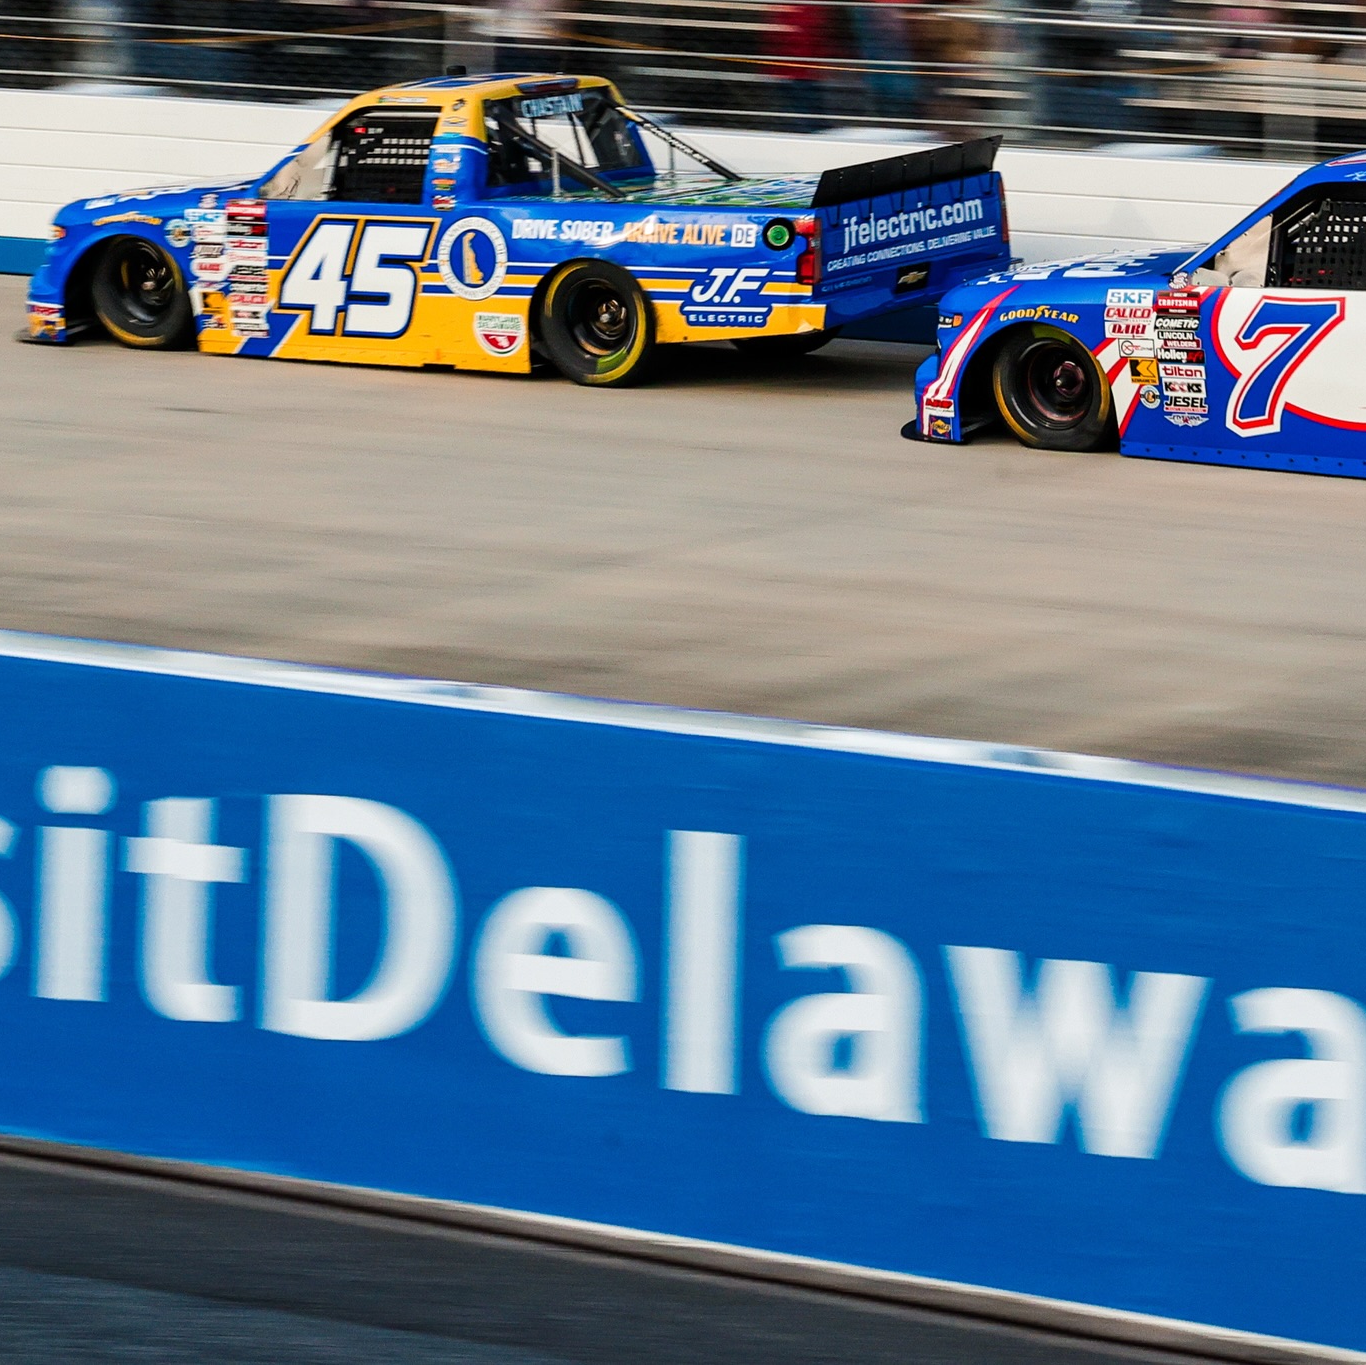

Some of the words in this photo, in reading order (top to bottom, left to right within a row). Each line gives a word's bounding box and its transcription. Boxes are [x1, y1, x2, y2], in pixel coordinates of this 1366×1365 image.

[511, 218, 559, 240] DRIVE
[560, 220, 616, 241] SOBER
[681, 223, 727, 245] ALIVE
[734, 226, 755, 245] DE
[843, 198, 984, 254] jfelectric.com
[827, 253, 866, 272] CREATING
[928, 230, 972, 250] DELIVERING
[279, 221, 433, 337] 45
[1108, 291, 1151, 304] SKF
[1158, 298, 1198, 307] CRAFTSMAN
[688, 314, 764, 323] ELECTRIC
[999, 305, 1080, 324] GOODYEAR
[1106, 307, 1152, 319] CALICO
[1155, 318, 1199, 329] COMETIC
[1158, 331, 1193, 340] LINCOLN
[1166, 339, 1197, 348] WELDERS
[1156, 348, 1187, 364] Holley
[1236, 296, 1346, 429] 7
[1162, 365, 1203, 377] tilton
[1164, 381, 1202, 394] KOOKS
[1165, 396, 1207, 409] JESEL
